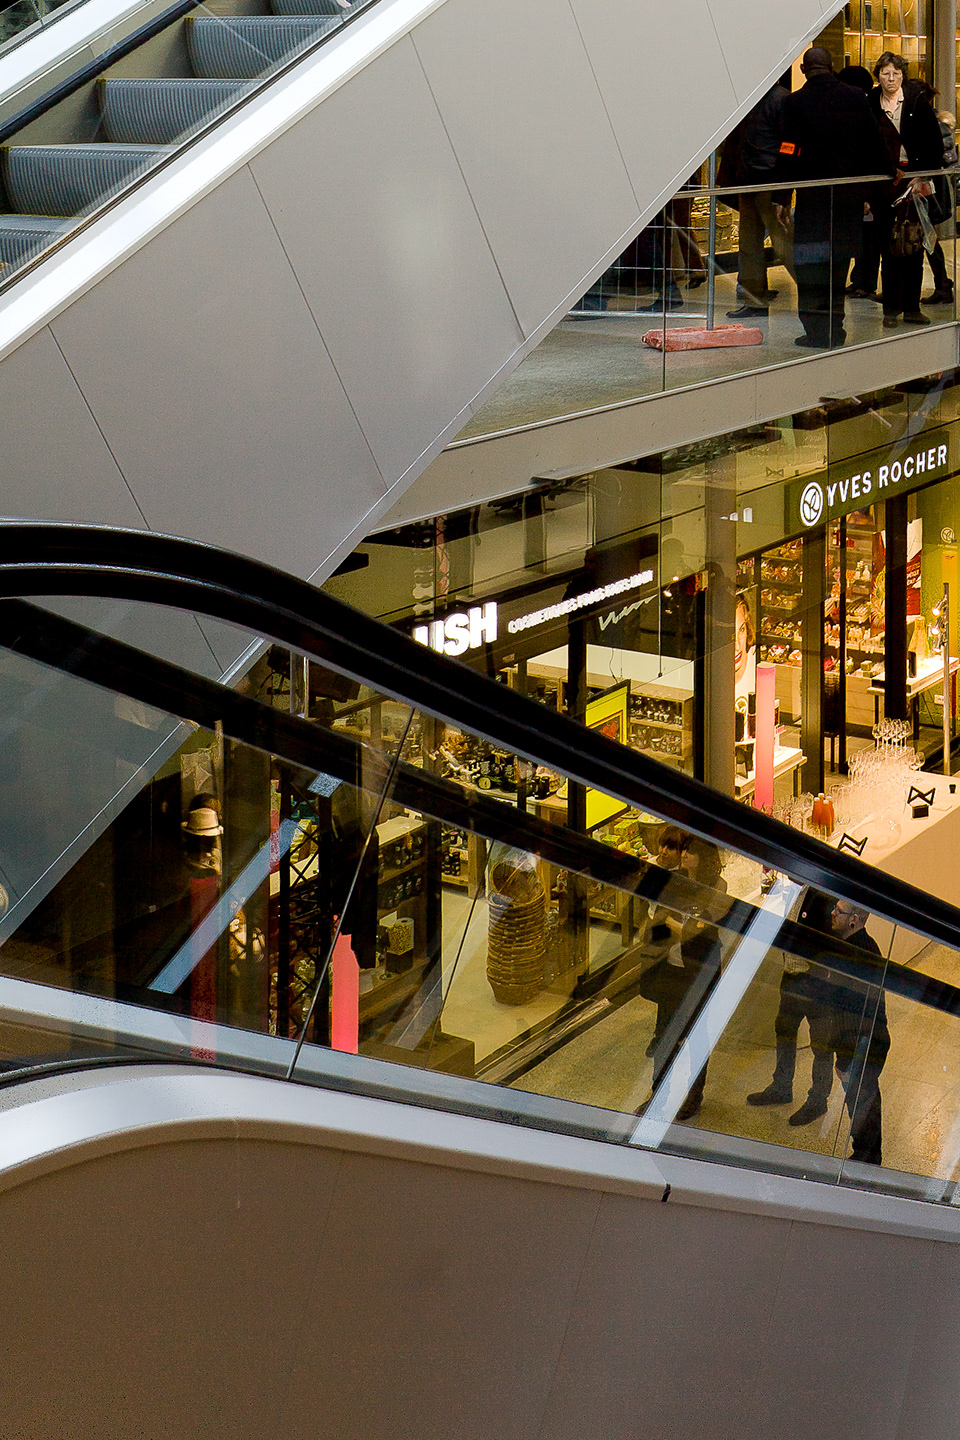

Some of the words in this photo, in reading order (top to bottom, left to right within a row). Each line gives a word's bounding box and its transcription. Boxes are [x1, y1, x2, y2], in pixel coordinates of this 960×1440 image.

[826, 471, 872, 507] YVES
[878, 444, 947, 489] ROCHER
[413, 601, 498, 656] USH
